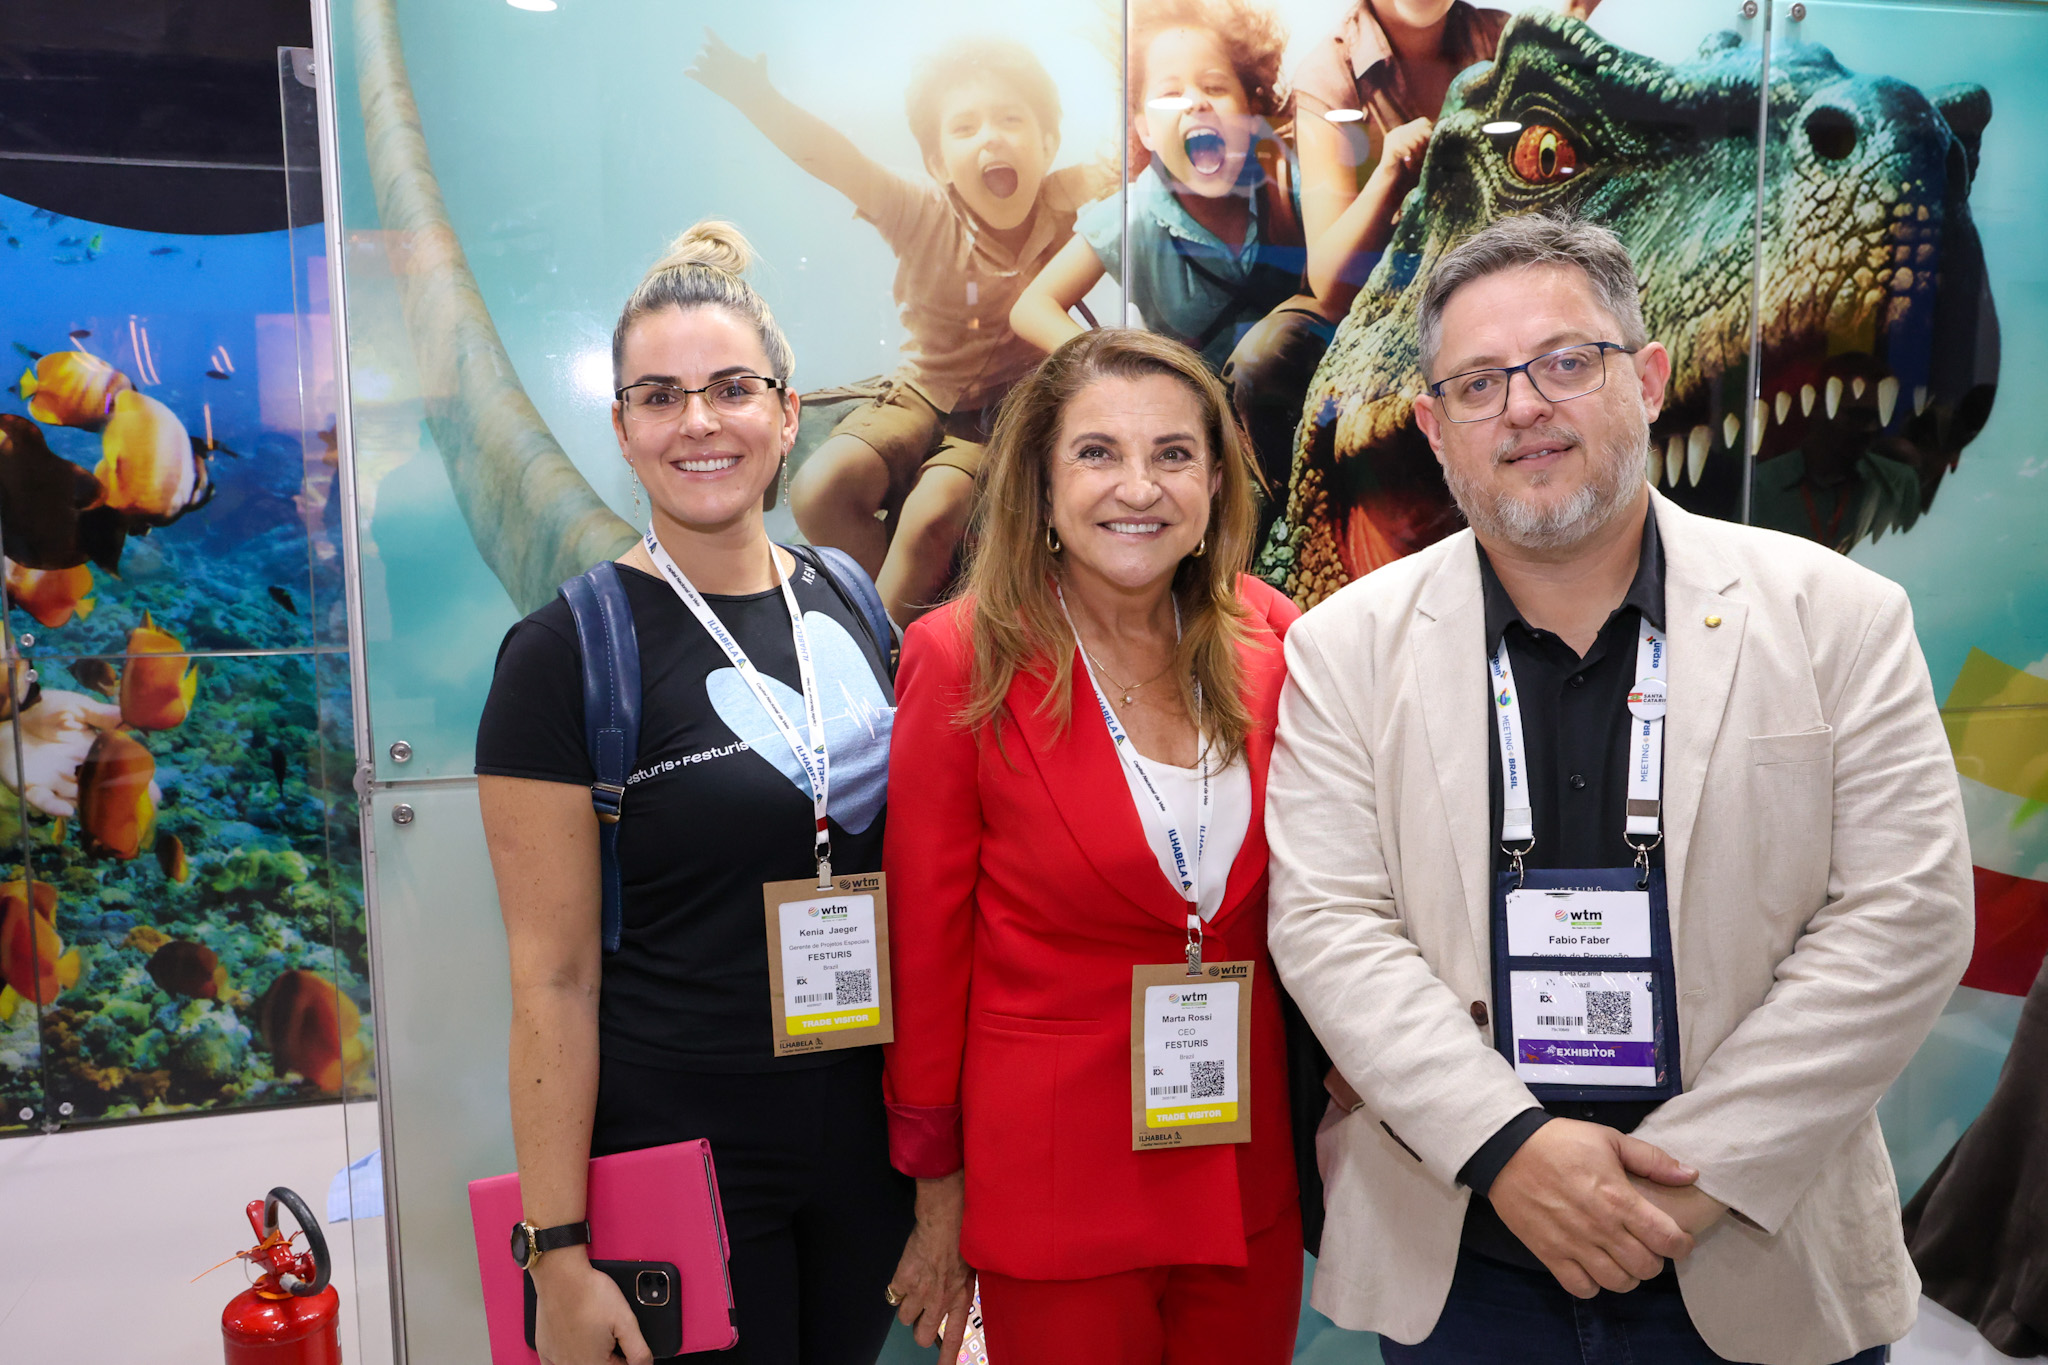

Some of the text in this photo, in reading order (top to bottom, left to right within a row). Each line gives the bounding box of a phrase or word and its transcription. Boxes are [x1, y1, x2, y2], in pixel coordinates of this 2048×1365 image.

[707, 619, 739, 657] ILHABELA
[795, 624, 809, 662] ILHABELA
[1652, 642, 1661, 668] expan
[1502, 715, 1517, 790] MEETING BRASIL
[626, 741, 749, 785] esturis Festuris
[1640, 743, 1649, 782] MEETING
[1168, 829, 1188, 878] ILHABELA
[852, 878, 879, 888] wtm
[821, 905, 848, 915] wtm
[1571, 909, 1602, 920] wtm
[800, 926, 858, 936] Kenia Jaeger
[820, 941, 842, 949] Projetos
[1549, 936, 1610, 944] Fabio Faber
[808, 950, 852, 961] FESTURIS
[1221, 965, 1247, 974] wtm
[1181, 992, 1207, 1001] wtm
[802, 1014, 869, 1028] TRADE VISITOR
[1162, 1013, 1212, 1023] Marta Rossi
[1178, 1028, 1196, 1036] CEO
[780, 1040, 813, 1049] ILHABELA
[1165, 1039, 1208, 1049] FESTURIS
[1556, 1048, 1616, 1058] EXHIBITOR
[1156, 1110, 1221, 1122] TRADE VISITOR
[1139, 1134, 1172, 1142] ILHABELA
